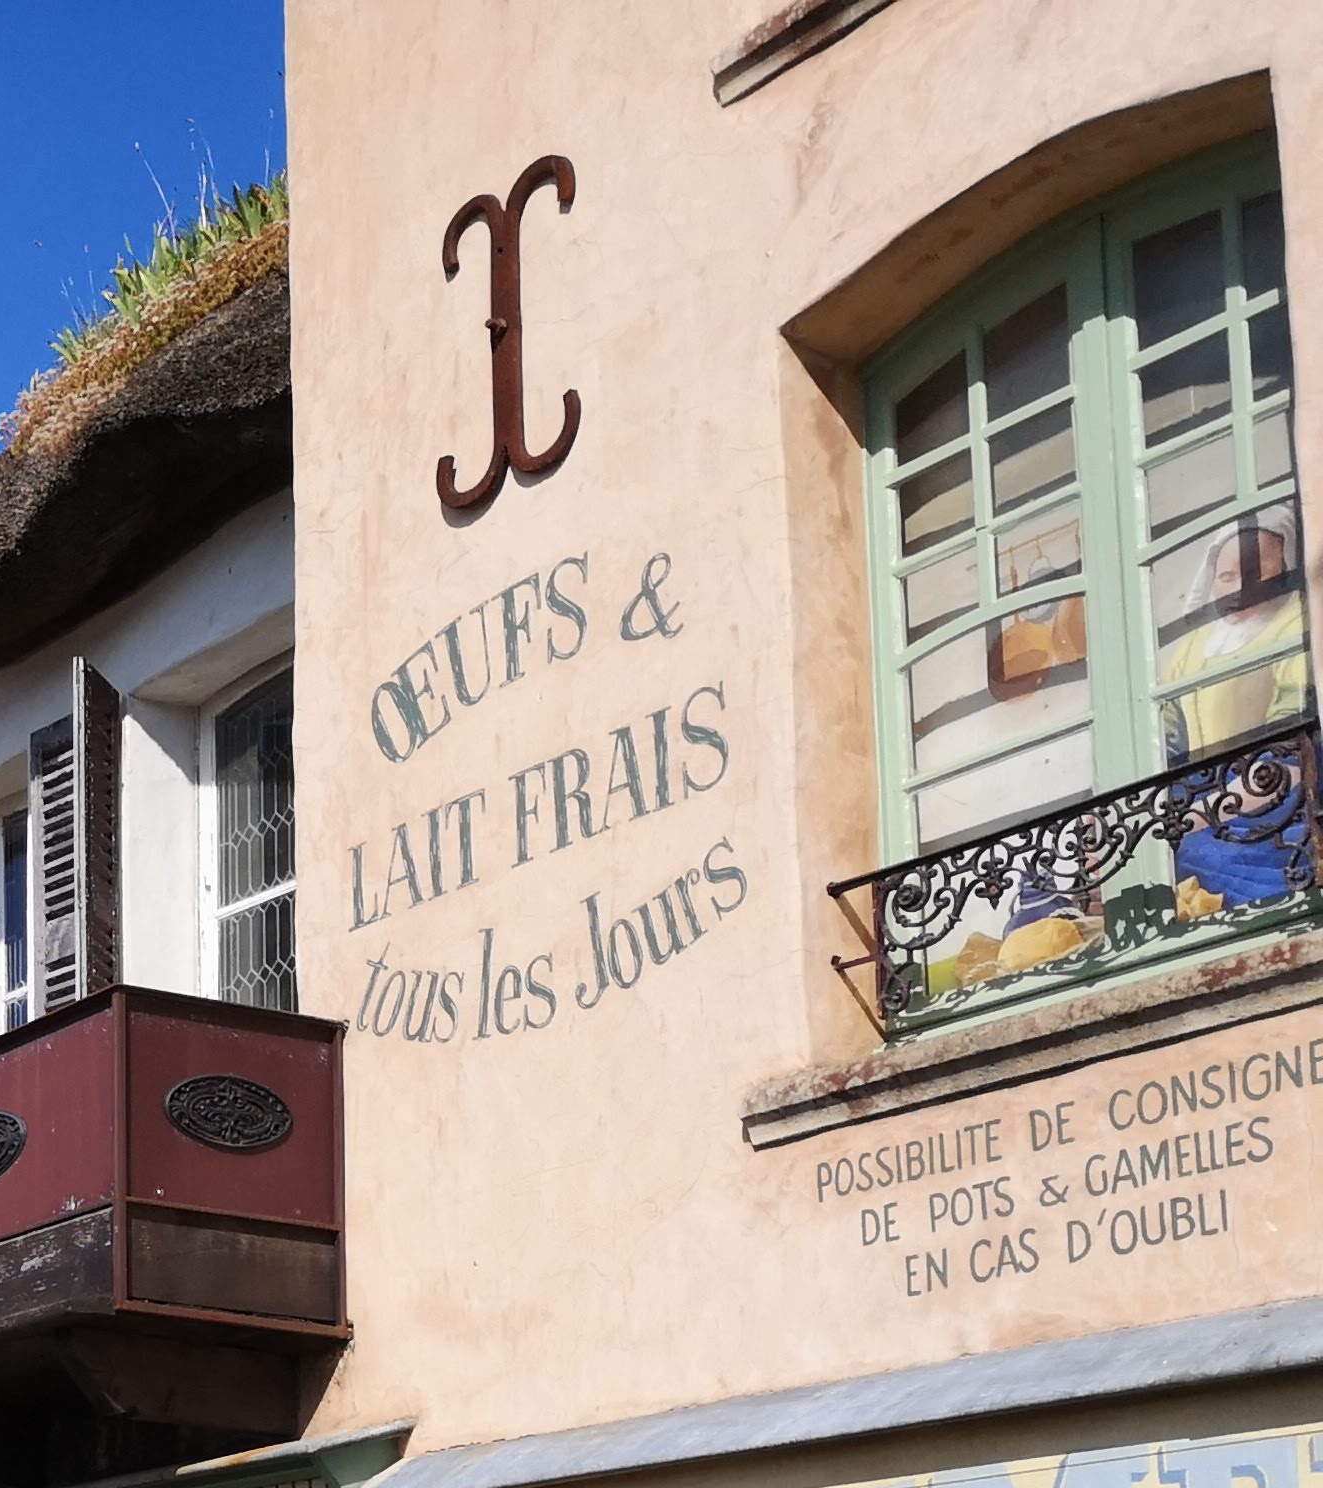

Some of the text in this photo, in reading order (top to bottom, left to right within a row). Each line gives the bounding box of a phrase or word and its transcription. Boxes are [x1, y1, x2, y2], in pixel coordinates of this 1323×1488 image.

[371, 551, 683, 763] ŒUFS &
[348, 680, 730, 933] LAIT FRAIS
[356, 836, 748, 1043] tous les Jours
[815, 1038, 1323, 1203] POSSIBILITE DE CONSIGNE
[860, 1116, 1274, 1247] DE POTS & GAMELLES
[905, 1189, 1228, 1297] EN CAS D'OUBLI
